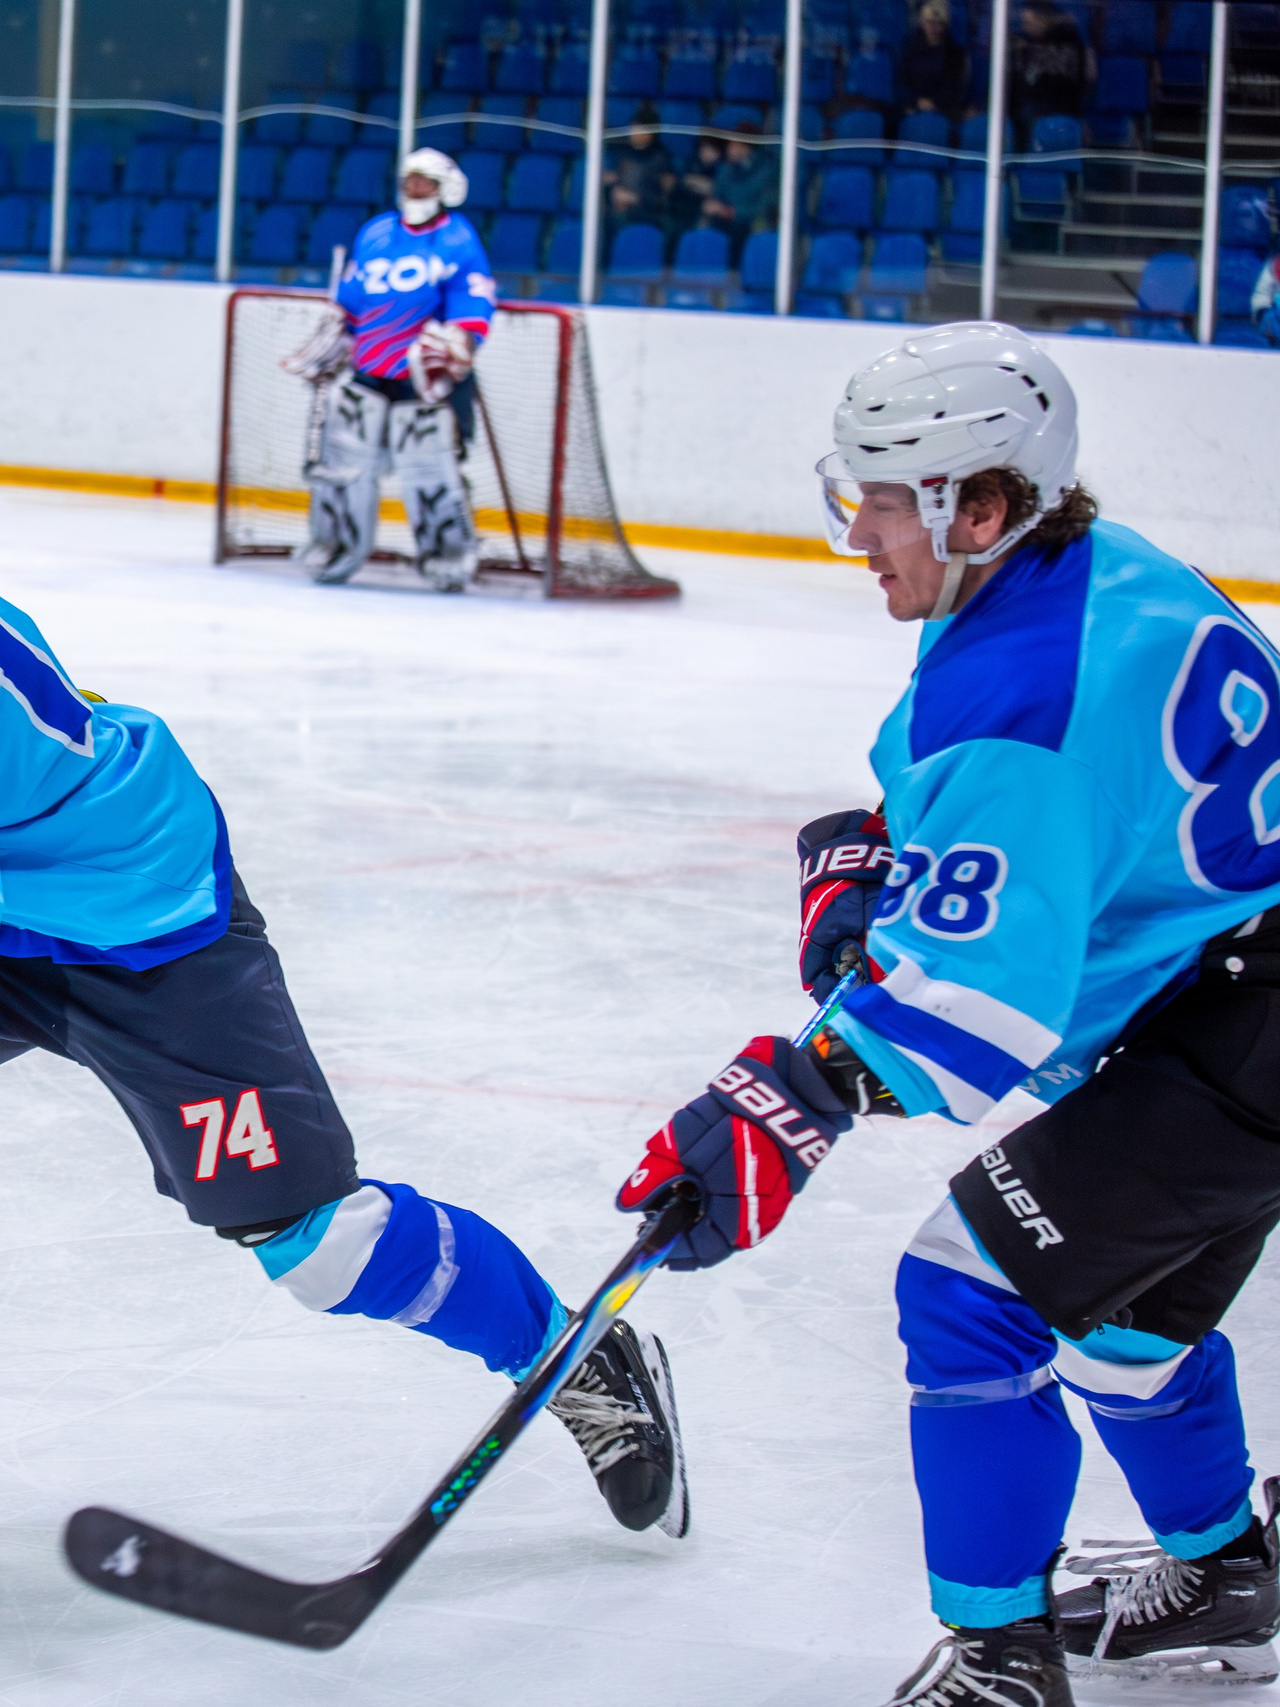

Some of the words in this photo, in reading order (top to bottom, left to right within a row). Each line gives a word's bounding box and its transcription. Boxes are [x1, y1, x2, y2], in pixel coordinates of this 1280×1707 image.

[799, 844, 898, 888] UER
[179, 1087, 281, 1182] 74
[710, 1063, 831, 1169] BAUE
[979, 1141, 1065, 1250] AUER
